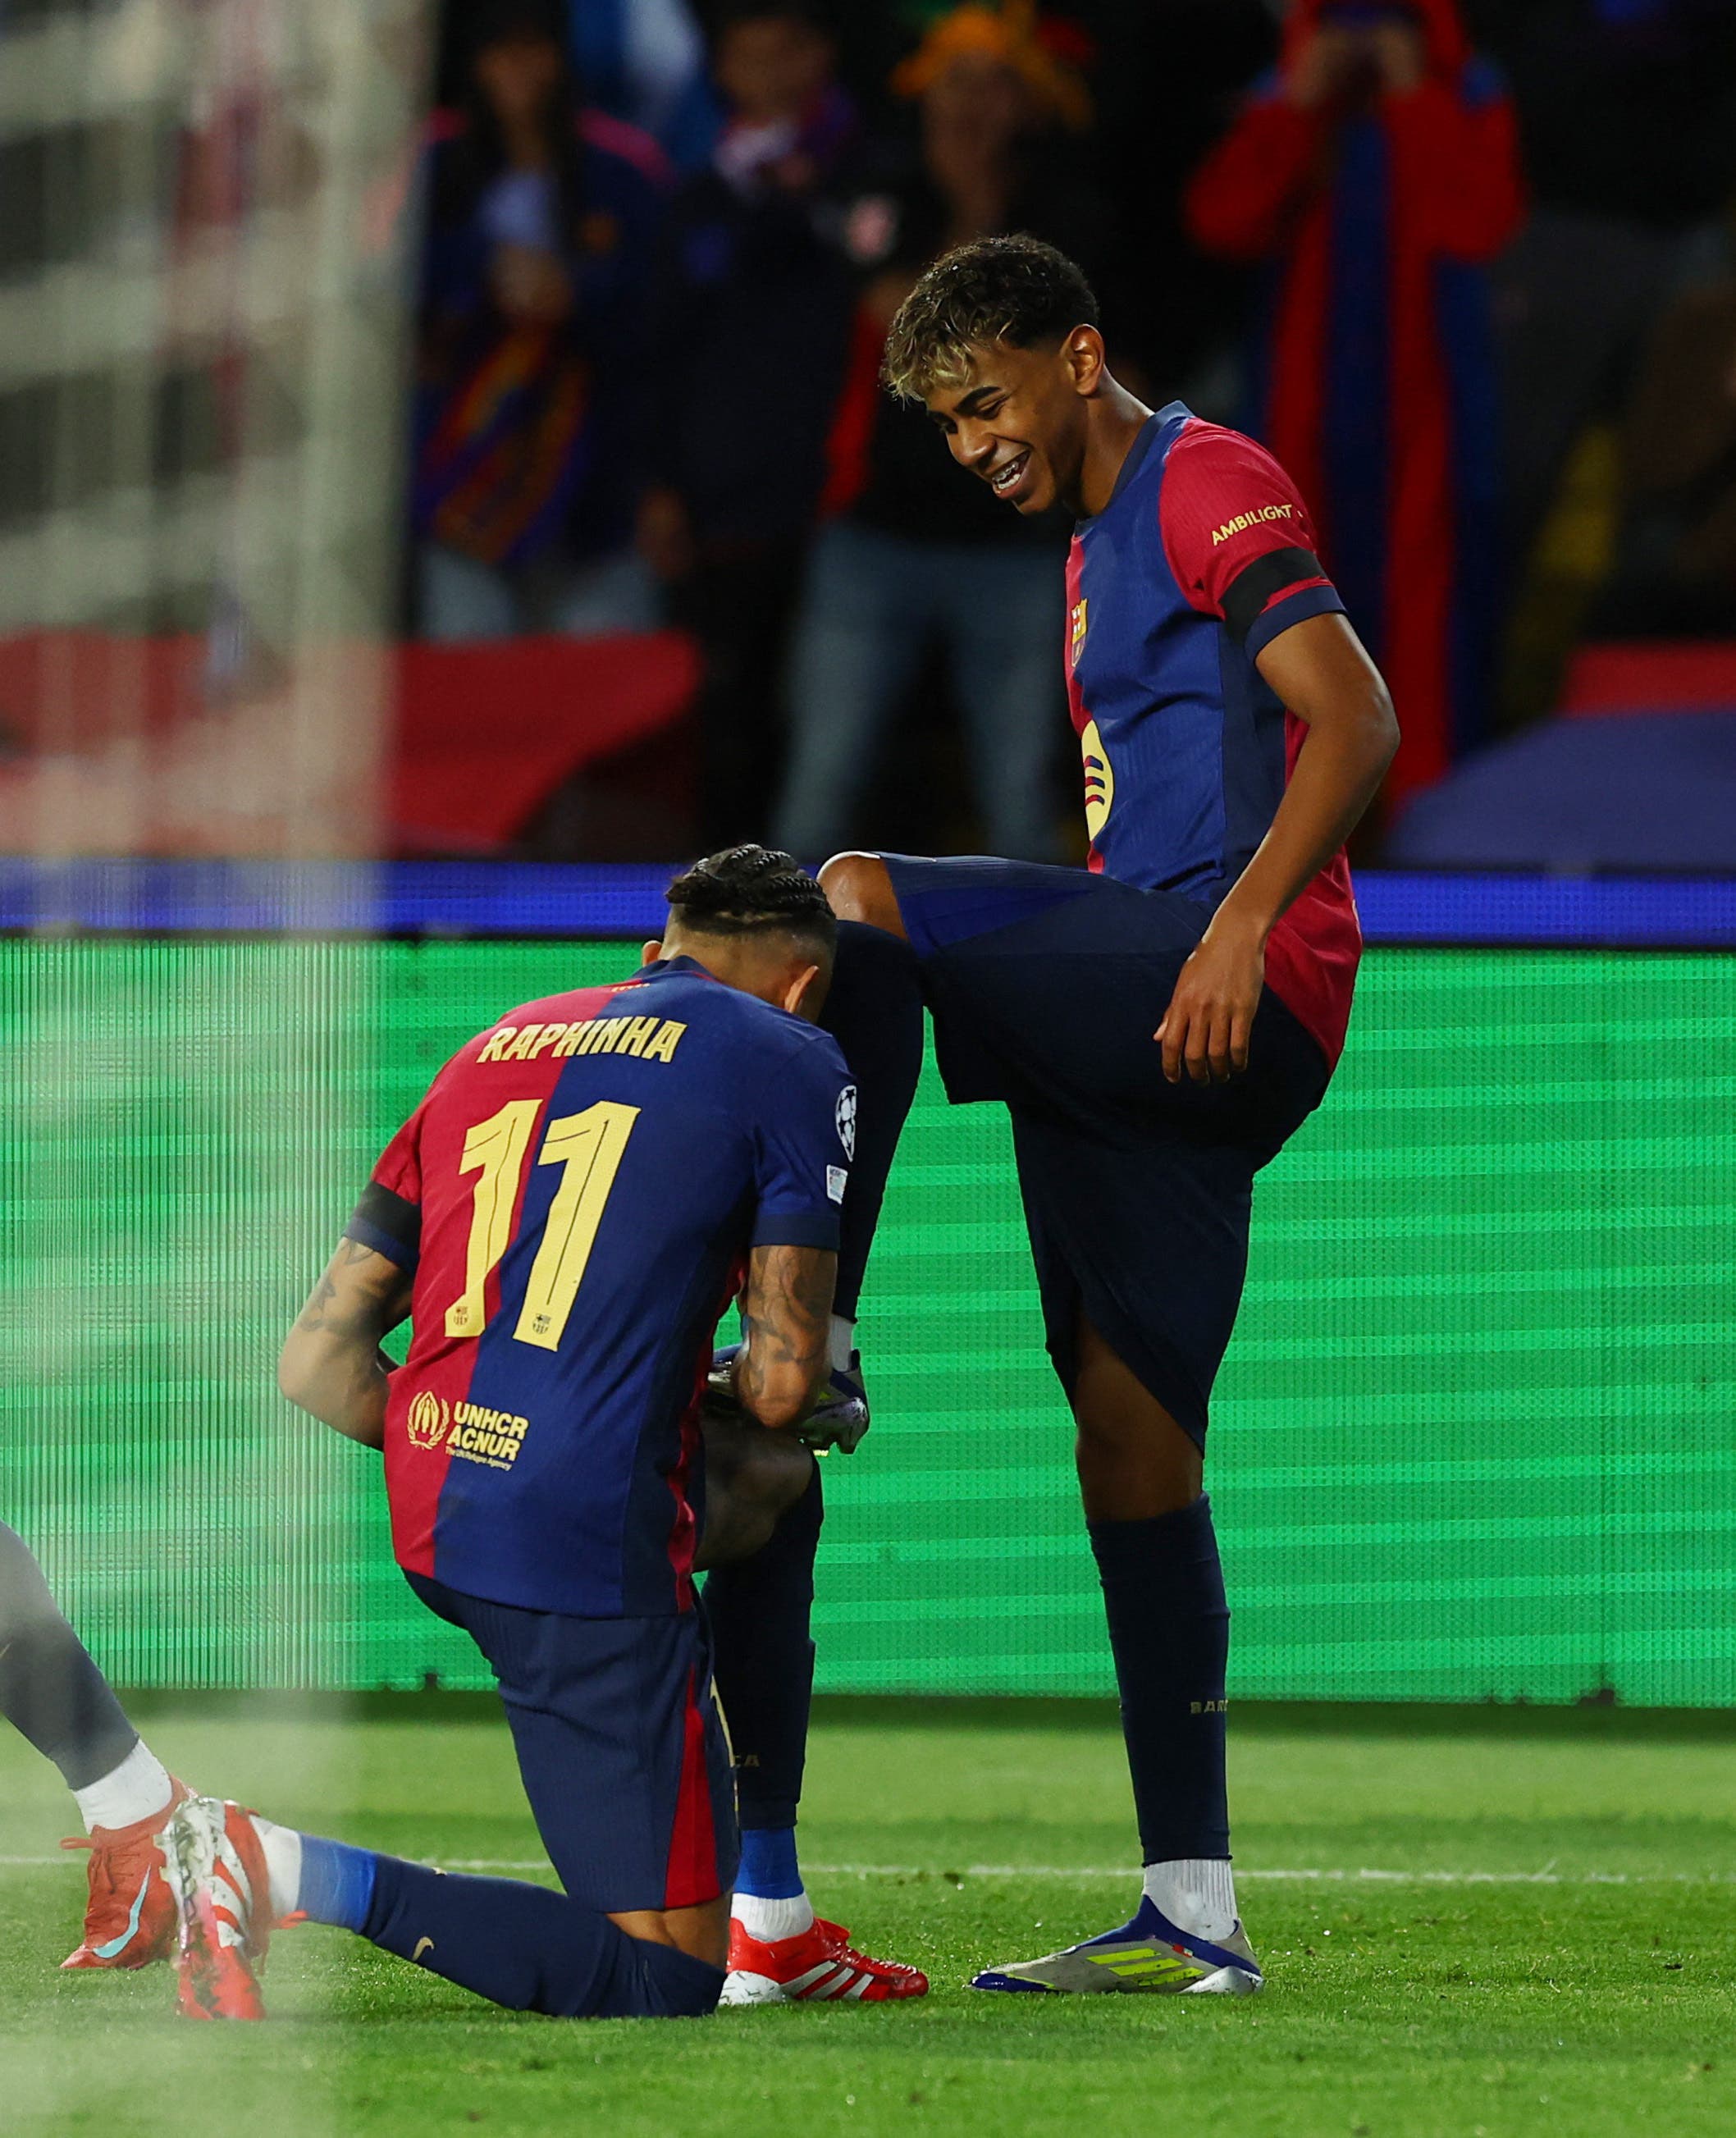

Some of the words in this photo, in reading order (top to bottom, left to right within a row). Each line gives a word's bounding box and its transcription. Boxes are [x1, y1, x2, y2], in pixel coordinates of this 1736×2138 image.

[1211, 504, 1293, 546] AMBILIGHT
[476, 1016, 688, 1063] RAPHINHA
[444, 1099, 642, 1352] 11
[453, 1400, 529, 1441] UNHCR
[445, 1424, 521, 1461] ACNUR
